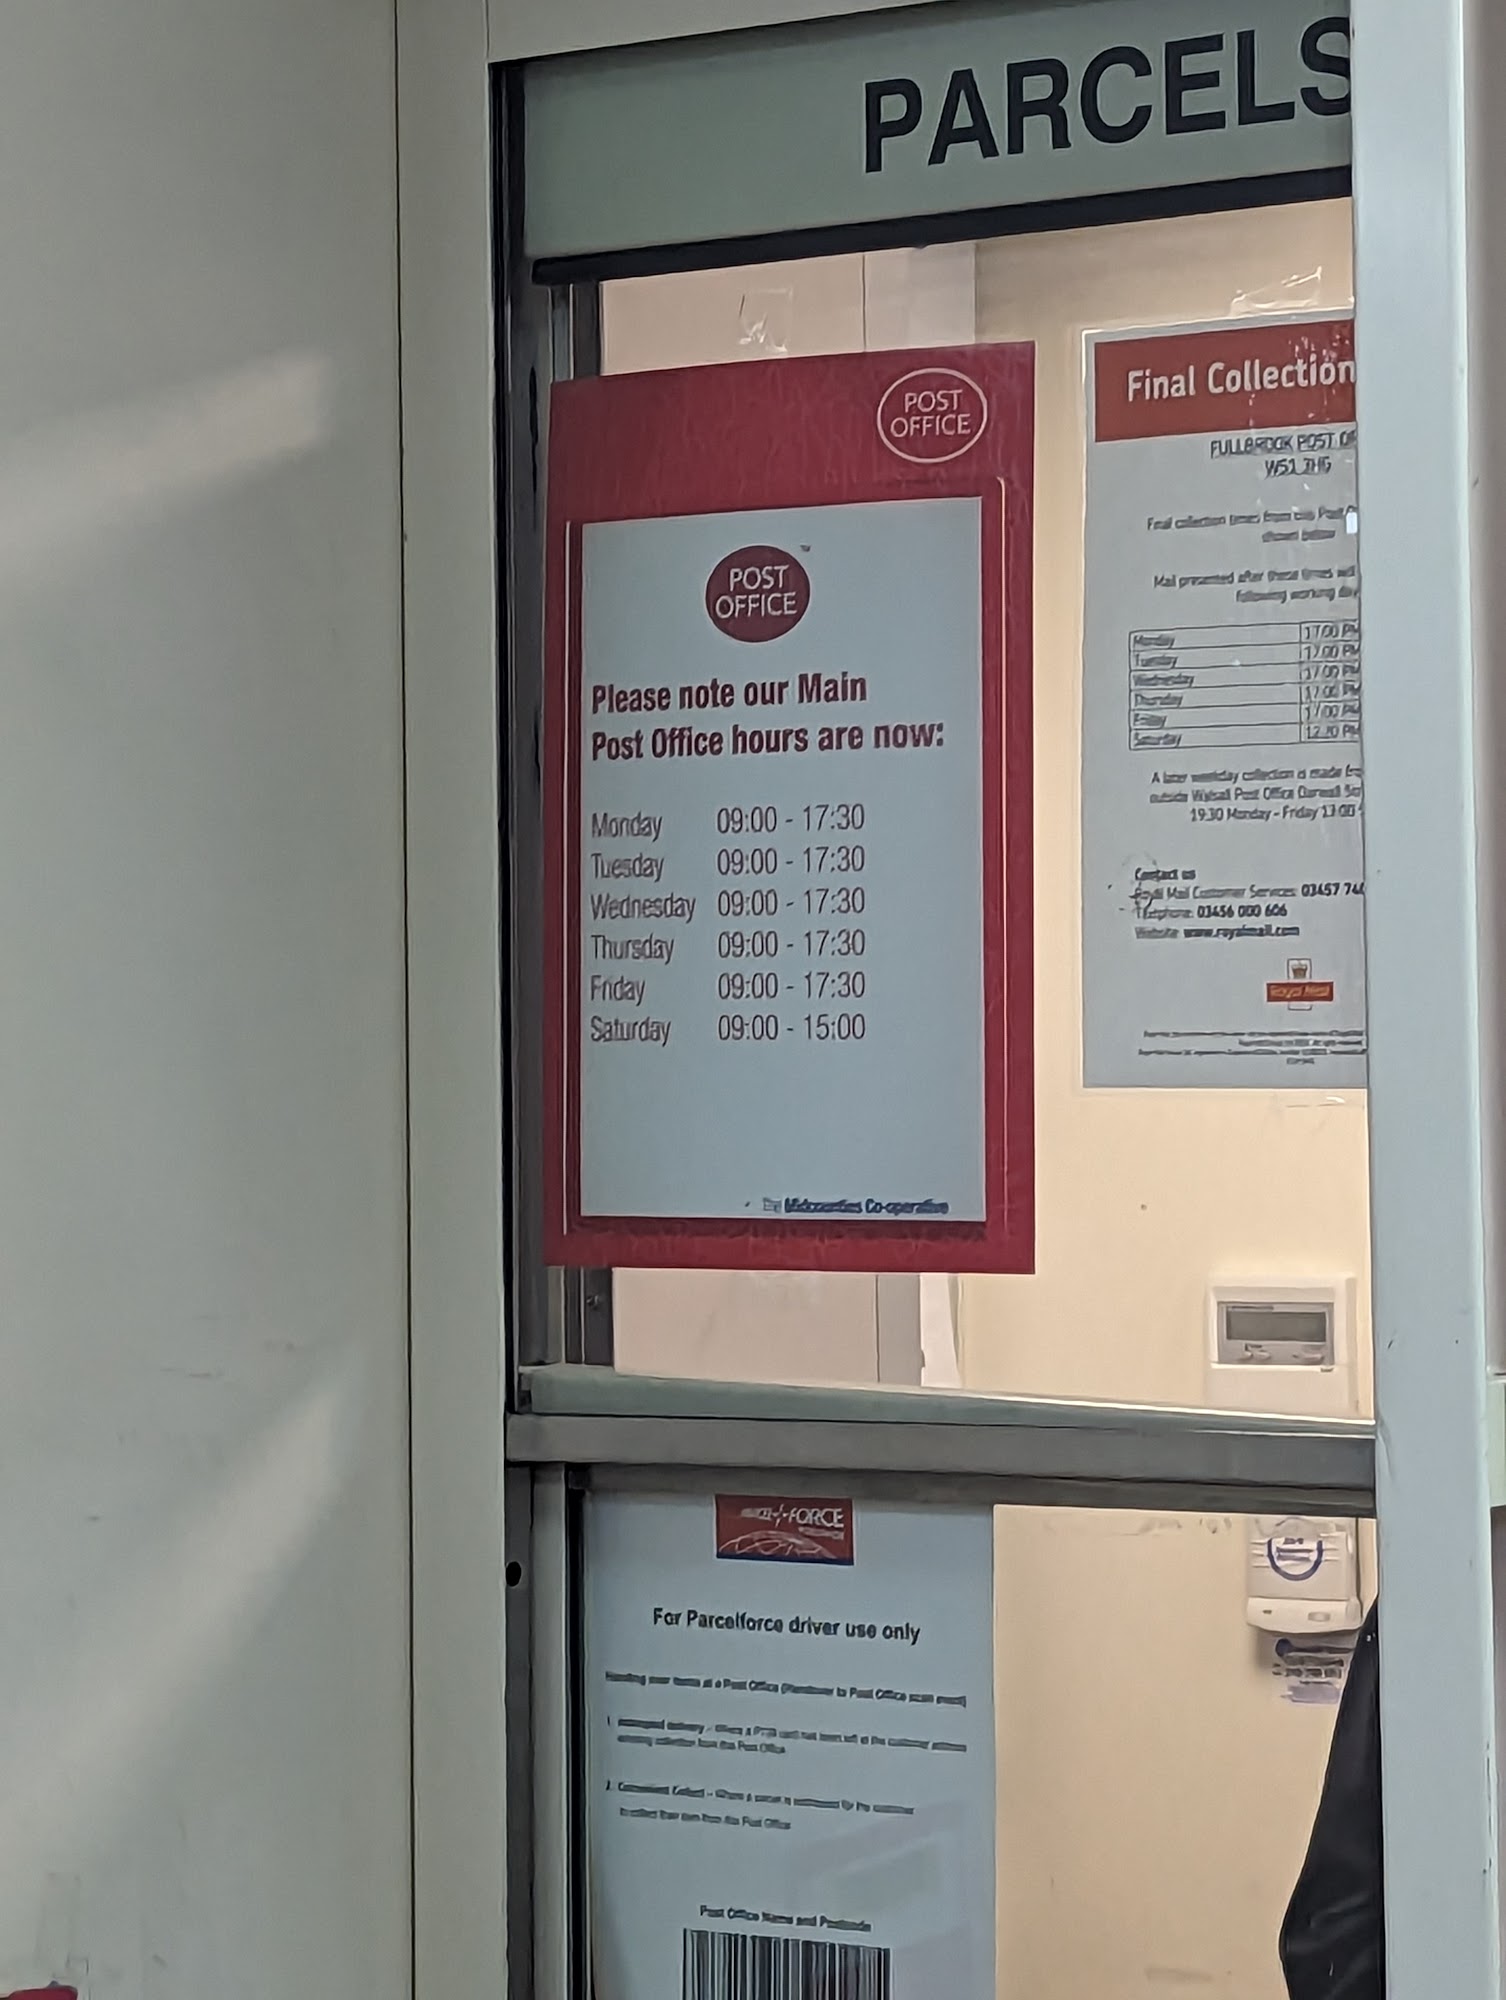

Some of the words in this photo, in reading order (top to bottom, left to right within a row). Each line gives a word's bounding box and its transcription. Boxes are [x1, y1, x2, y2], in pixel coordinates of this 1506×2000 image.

[865, 16, 1351, 173] PARCELS
[1127, 365, 1196, 402] Final
[1207, 353, 1356, 395] Collection
[904, 389, 963, 412] POST
[890, 413, 971, 438] OFFICE
[1297, 432, 1335, 451] POST
[729, 565, 790, 592] POST
[715, 592, 798, 619] OFFICE
[592, 684, 671, 714] Please
[679, 678, 735, 710] note
[743, 678, 789, 706] our
[798, 671, 867, 703] Main
[592, 730, 644, 760] Post
[651, 726, 724, 758] Office
[732, 724, 809, 754] hours
[818, 725, 864, 752] are
[873, 721, 945, 749] now:
[591, 813, 663, 842] Monday
[716, 806, 777, 833] 09:00
[803, 804, 866, 831] 17:30
[591, 853, 665, 883] Tuesday
[716, 848, 777, 875] 09:00
[803, 845, 866, 873] 17:30
[591, 892, 697, 923] Wednesday
[717, 889, 778, 917] 09:00
[803, 887, 866, 914] 17:30
[591, 933, 675, 965] Thursday
[717, 930, 778, 958] 09:00
[803, 928, 866, 956] 17:30
[591, 975, 646, 1006] Friday
[717, 972, 778, 999] 09:00
[803, 971, 866, 998] 17:30
[591, 1015, 672, 1046] Saturday
[717, 1014, 778, 1041] 09:00
[803, 1013, 866, 1040] 15:00
[653, 1607, 683, 1627] For
[686, 1609, 785, 1635] Parcelforce
[788, 1614, 842, 1638] driver
[845, 1621, 878, 1641] use
[882, 1621, 922, 1646] only
